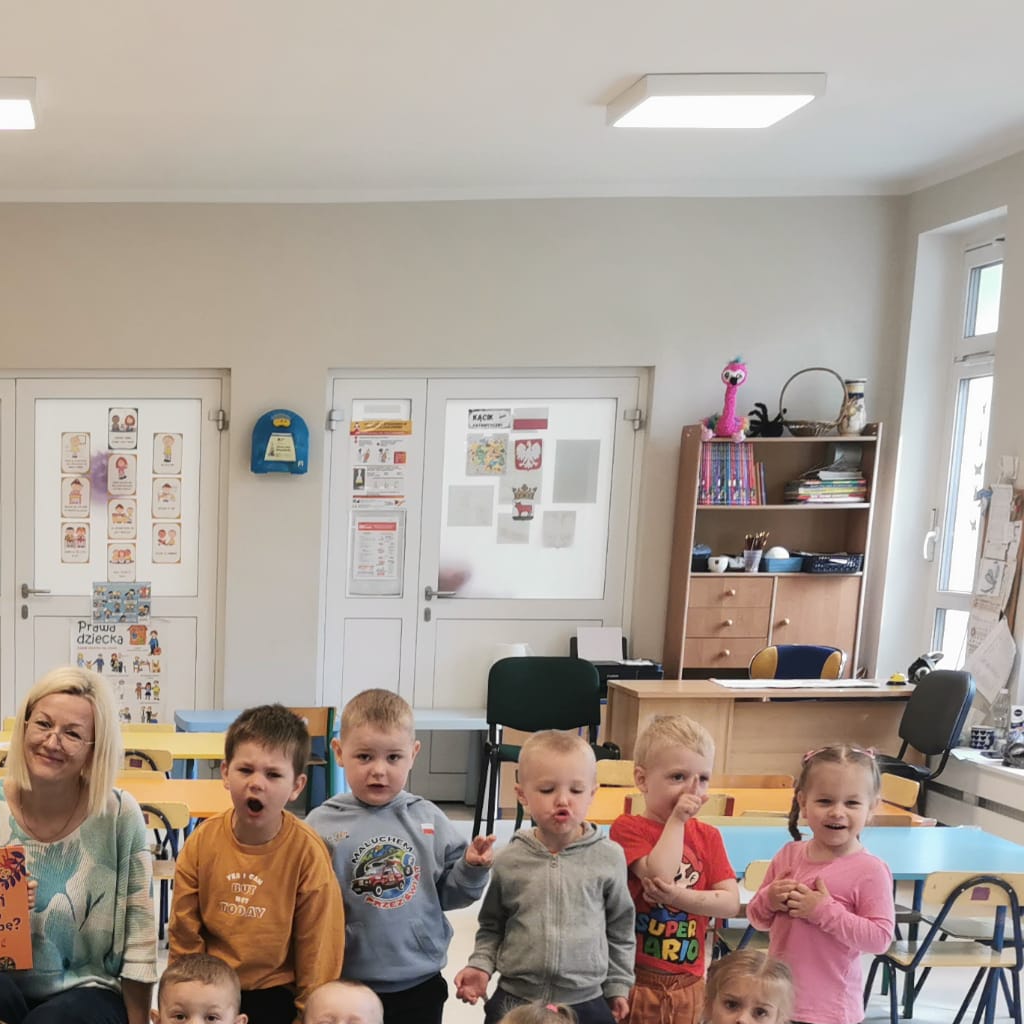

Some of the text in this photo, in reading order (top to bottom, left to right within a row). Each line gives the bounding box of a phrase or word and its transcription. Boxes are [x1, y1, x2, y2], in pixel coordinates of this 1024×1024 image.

[77, 620, 116, 634] Prawa
[76, 633, 124, 645] dziecka
[351, 836, 414, 864] MALUCHEM
[231, 882, 257, 895] BUT
[220, 901, 266, 919] TODAY
[636, 914, 697, 938] SUPER
[643, 937, 699, 964] ARIO
